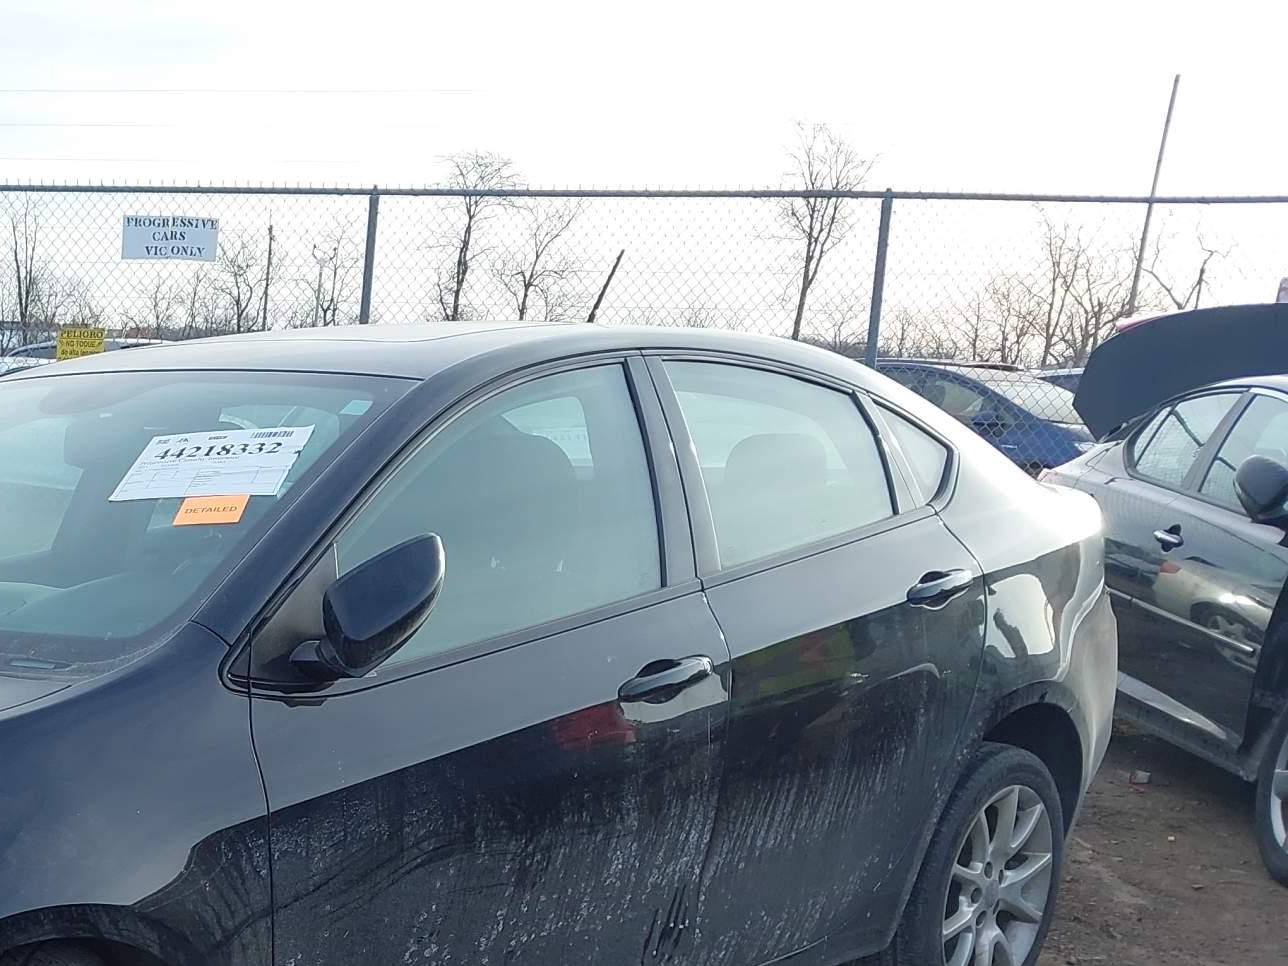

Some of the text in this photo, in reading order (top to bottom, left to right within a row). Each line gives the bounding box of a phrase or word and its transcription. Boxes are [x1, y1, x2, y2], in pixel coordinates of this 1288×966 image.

[127, 217, 218, 230] PROGRESSIVE
[152, 230, 187, 241] CARS
[145, 245, 205, 257] VIC ONLY
[154, 442, 282, 459] 44218332
[184, 506, 238, 514] DETAILED
